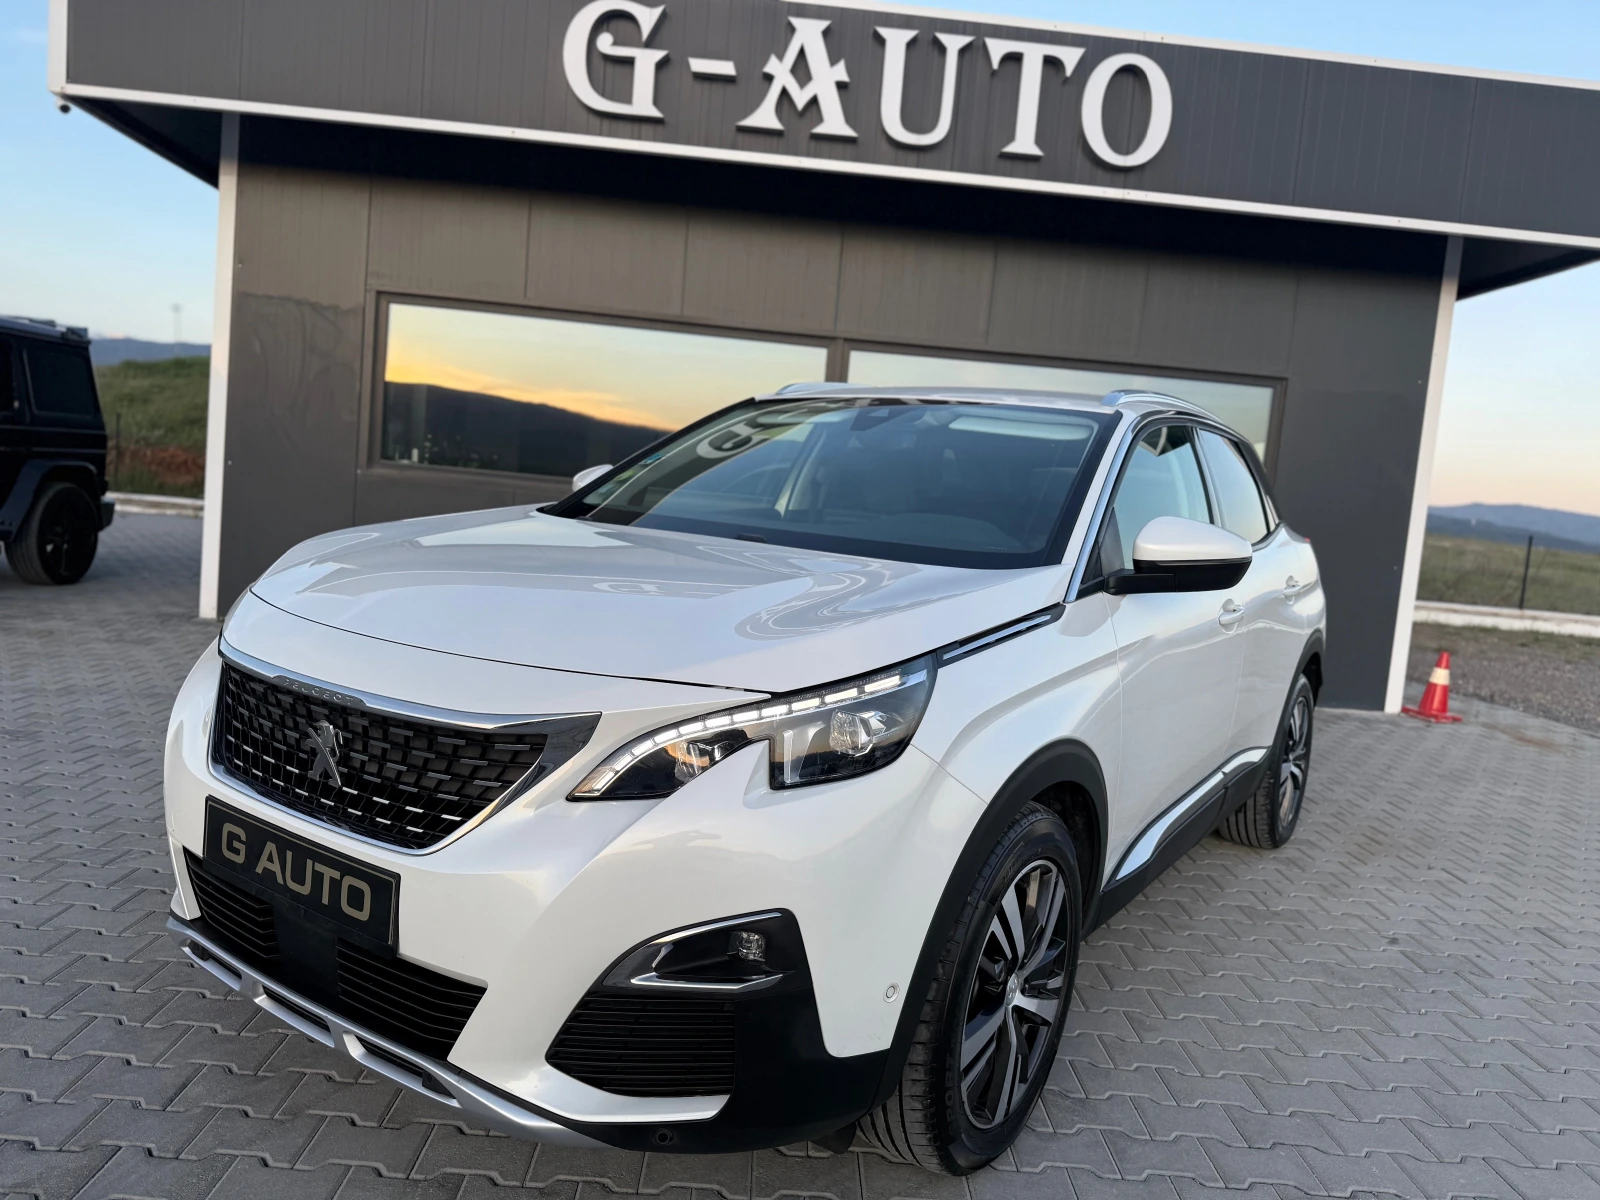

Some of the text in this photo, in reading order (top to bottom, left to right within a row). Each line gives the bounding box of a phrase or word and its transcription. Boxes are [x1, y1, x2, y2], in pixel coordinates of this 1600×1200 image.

[562, 0, 1173, 168] G-AUTO
[221, 822, 372, 922] G AUTO
